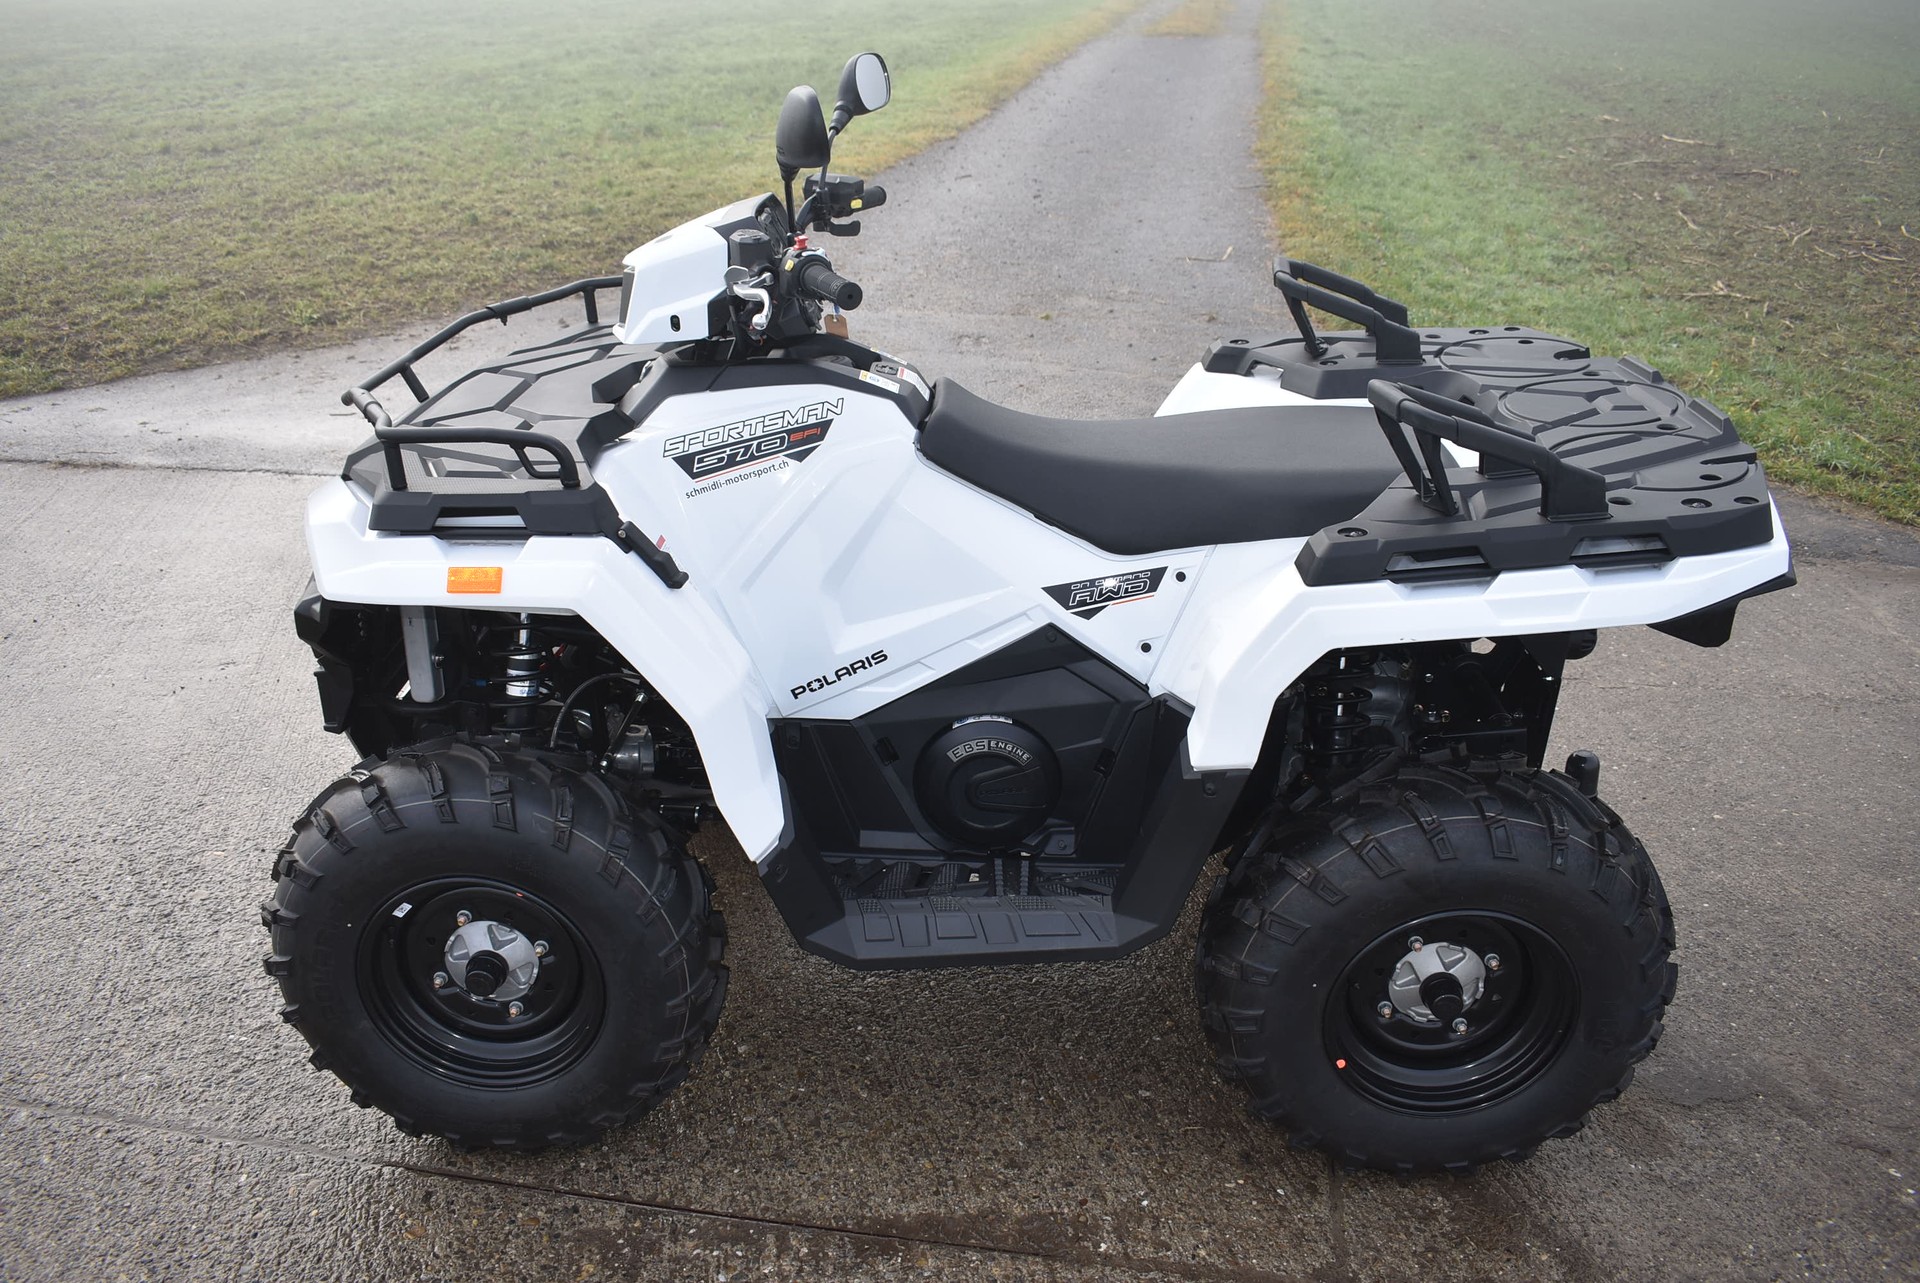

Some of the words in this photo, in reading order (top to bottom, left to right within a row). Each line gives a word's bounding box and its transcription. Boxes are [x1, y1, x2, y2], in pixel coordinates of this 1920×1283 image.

[663, 398, 844, 457] SPORTSMAN
[693, 433, 788, 473] 570
[685, 460, 790, 499] schmidli-motorsport.ch
[1068, 578, 1150, 606] AWD
[1071, 582, 1089, 590] ON
[790, 649, 889, 700] POLARIS
[951, 740, 986, 760] EBS
[990, 740, 1030, 761] ENGINE
